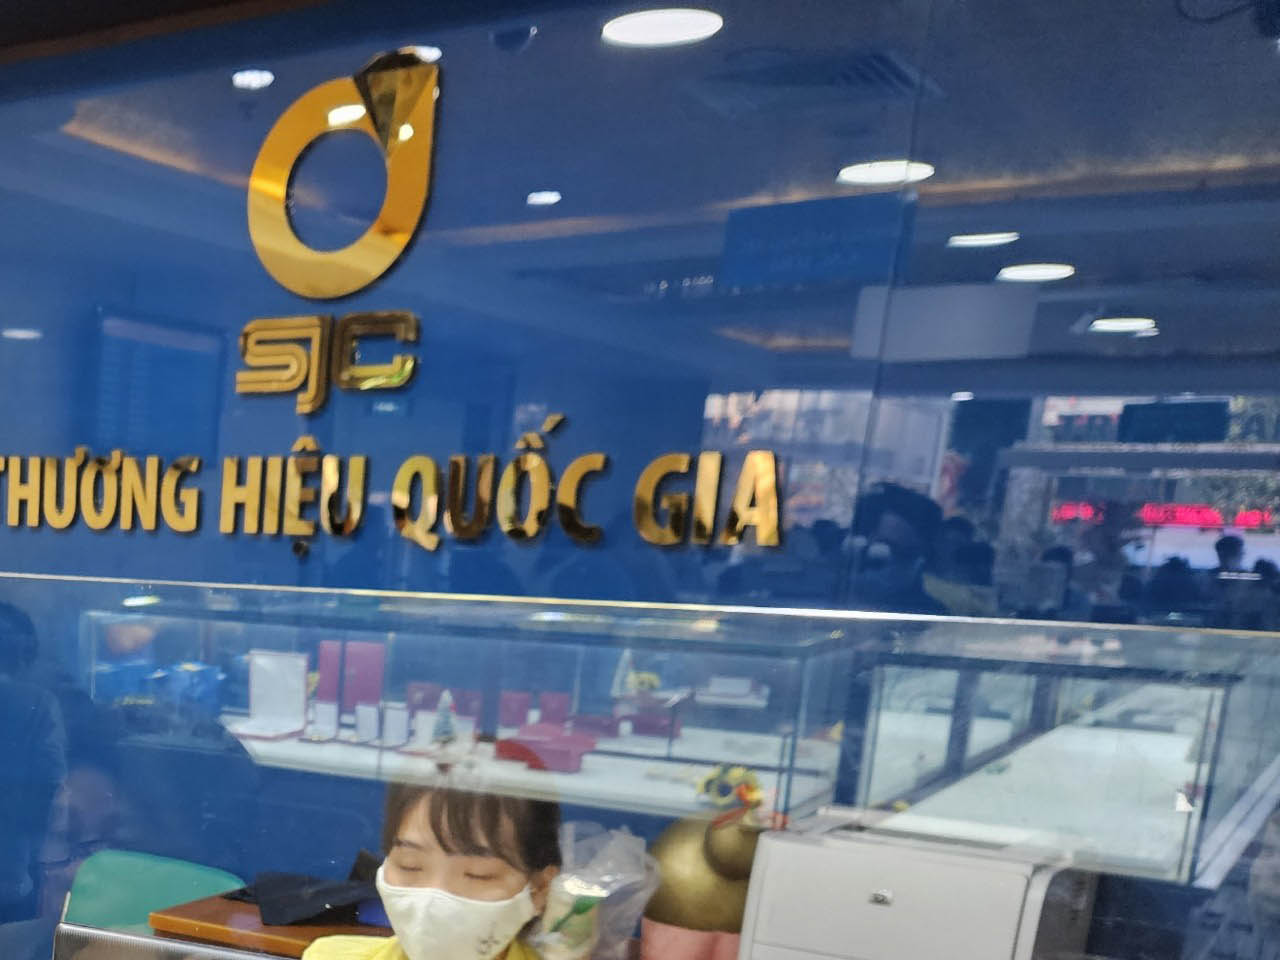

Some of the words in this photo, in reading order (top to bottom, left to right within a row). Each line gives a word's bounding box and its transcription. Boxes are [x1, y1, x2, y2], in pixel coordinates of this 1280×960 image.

[219, 435, 368, 557] HIỆU
[389, 413, 610, 553] QUỐC
[633, 449, 784, 549] GIA
